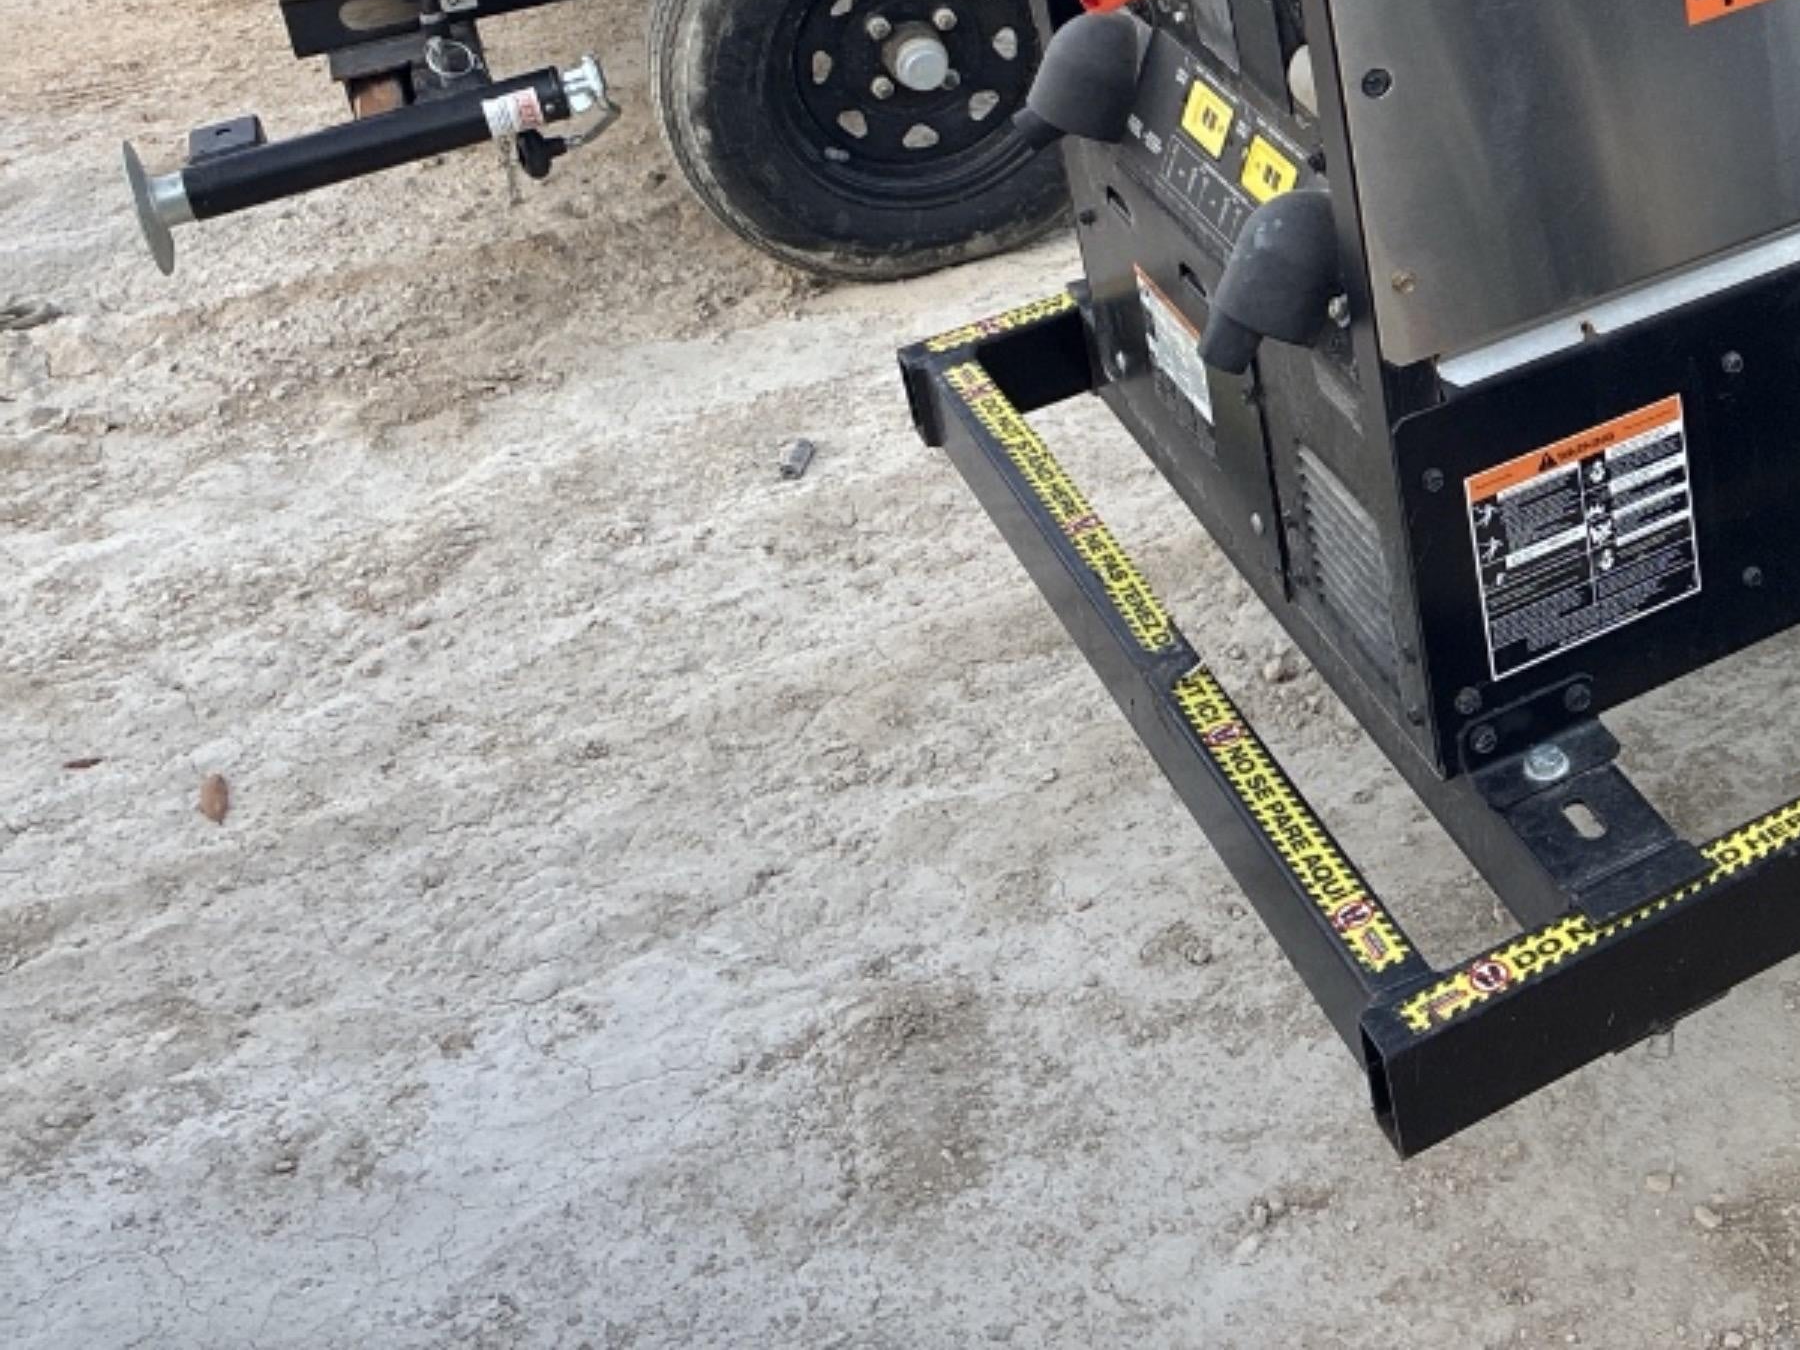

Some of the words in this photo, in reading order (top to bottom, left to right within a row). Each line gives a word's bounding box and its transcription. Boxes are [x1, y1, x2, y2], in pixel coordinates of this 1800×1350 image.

[1227, 744, 1257, 775] NO
[1246, 773, 1277, 802] SE
[1263, 800, 1315, 854] PARE
[1510, 937, 1564, 969] DO
